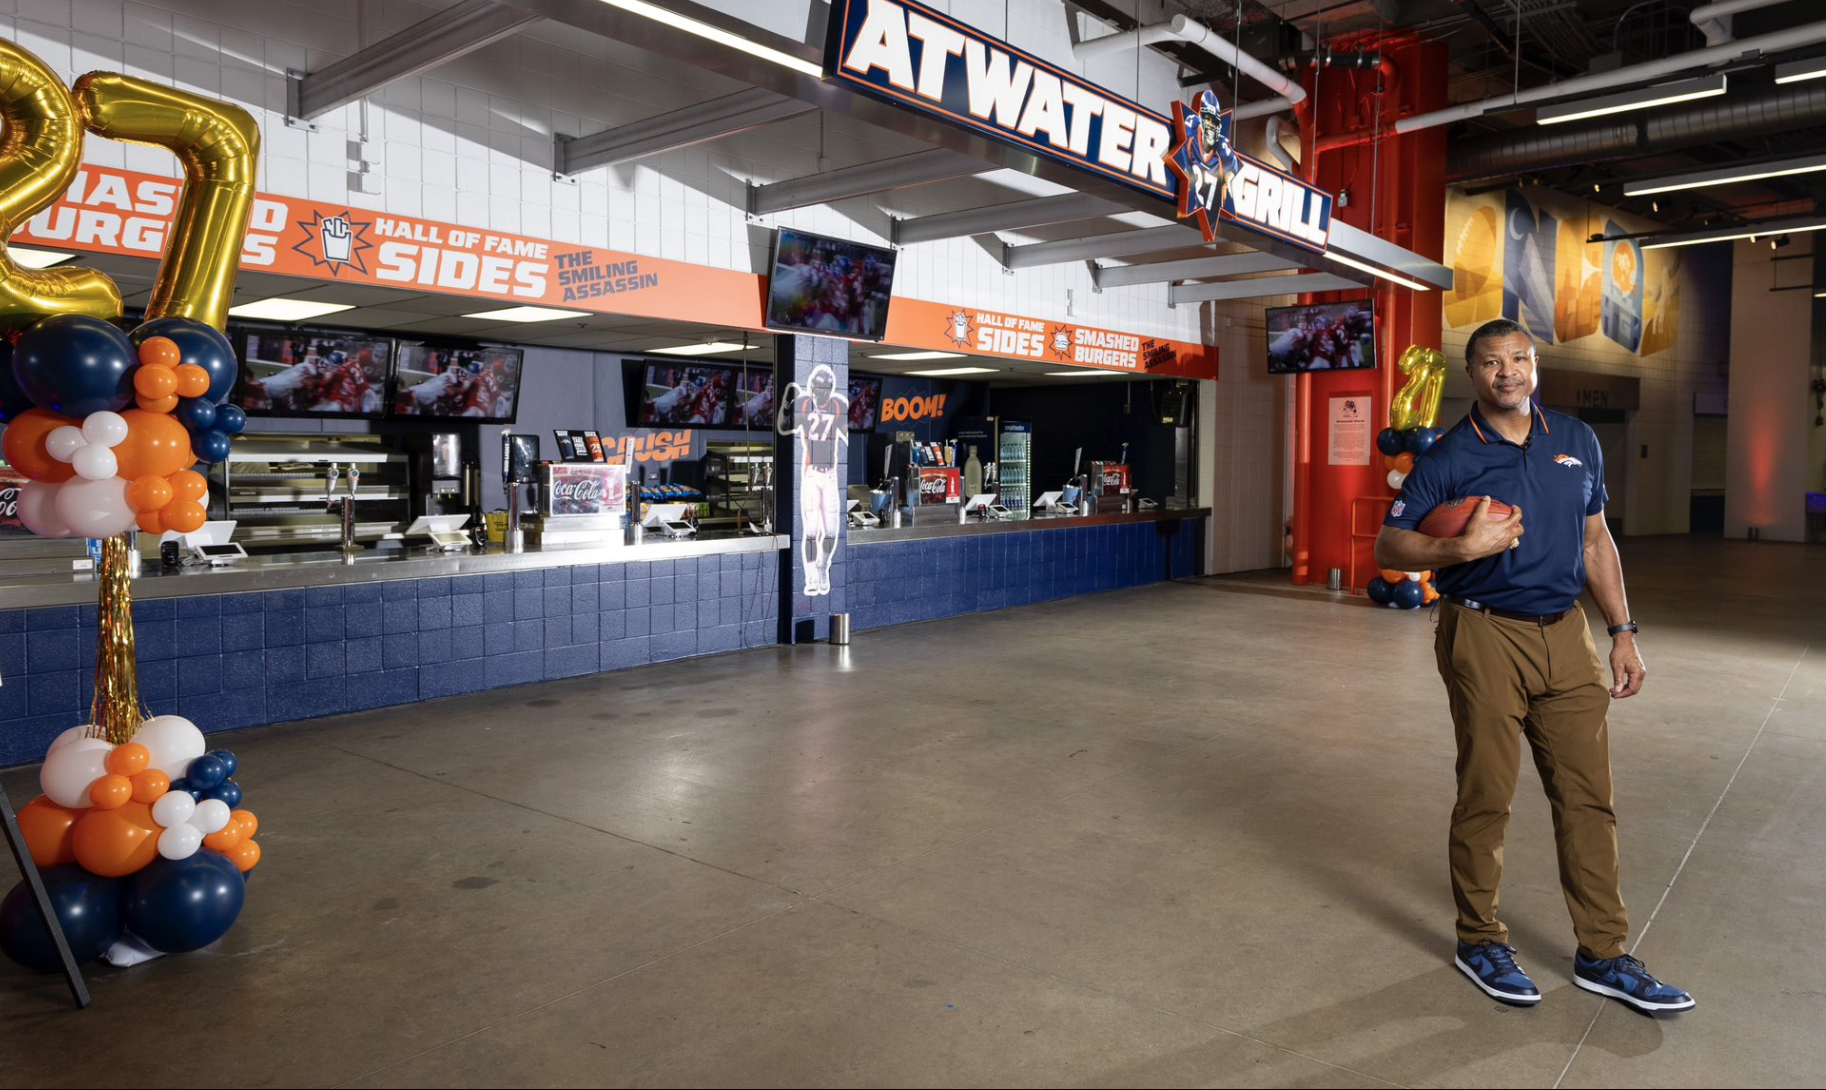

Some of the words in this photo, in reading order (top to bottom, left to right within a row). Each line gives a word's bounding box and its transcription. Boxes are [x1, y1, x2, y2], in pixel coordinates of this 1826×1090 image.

[843, 0, 1171, 188] ATWATER
[1191, 163, 1218, 211] 27
[1231, 161, 1326, 246] GRILL
[374, 217, 443, 245] HALL
[448, 230, 481, 249] OF
[484, 235, 549, 260] FAME
[376, 241, 550, 298] SIDES
[554, 251, 593, 270] THE
[557, 260, 638, 286] SMILING
[562, 273, 658, 302] ASSASSIN
[976, 312, 1002, 327] HALL
[1004, 316, 1017, 328] OF
[1018, 319, 1045, 333] FAME
[976, 326, 1045, 357] SIDES
[1074, 328, 1139, 352] SMASHED
[1142, 339, 1155, 349] THE
[1074, 345, 1137, 368] BURGERS
[880, 393, 947, 423] BOOM!
[806, 413, 835, 441] 27
[553, 480, 601, 500] Coca-Cola
